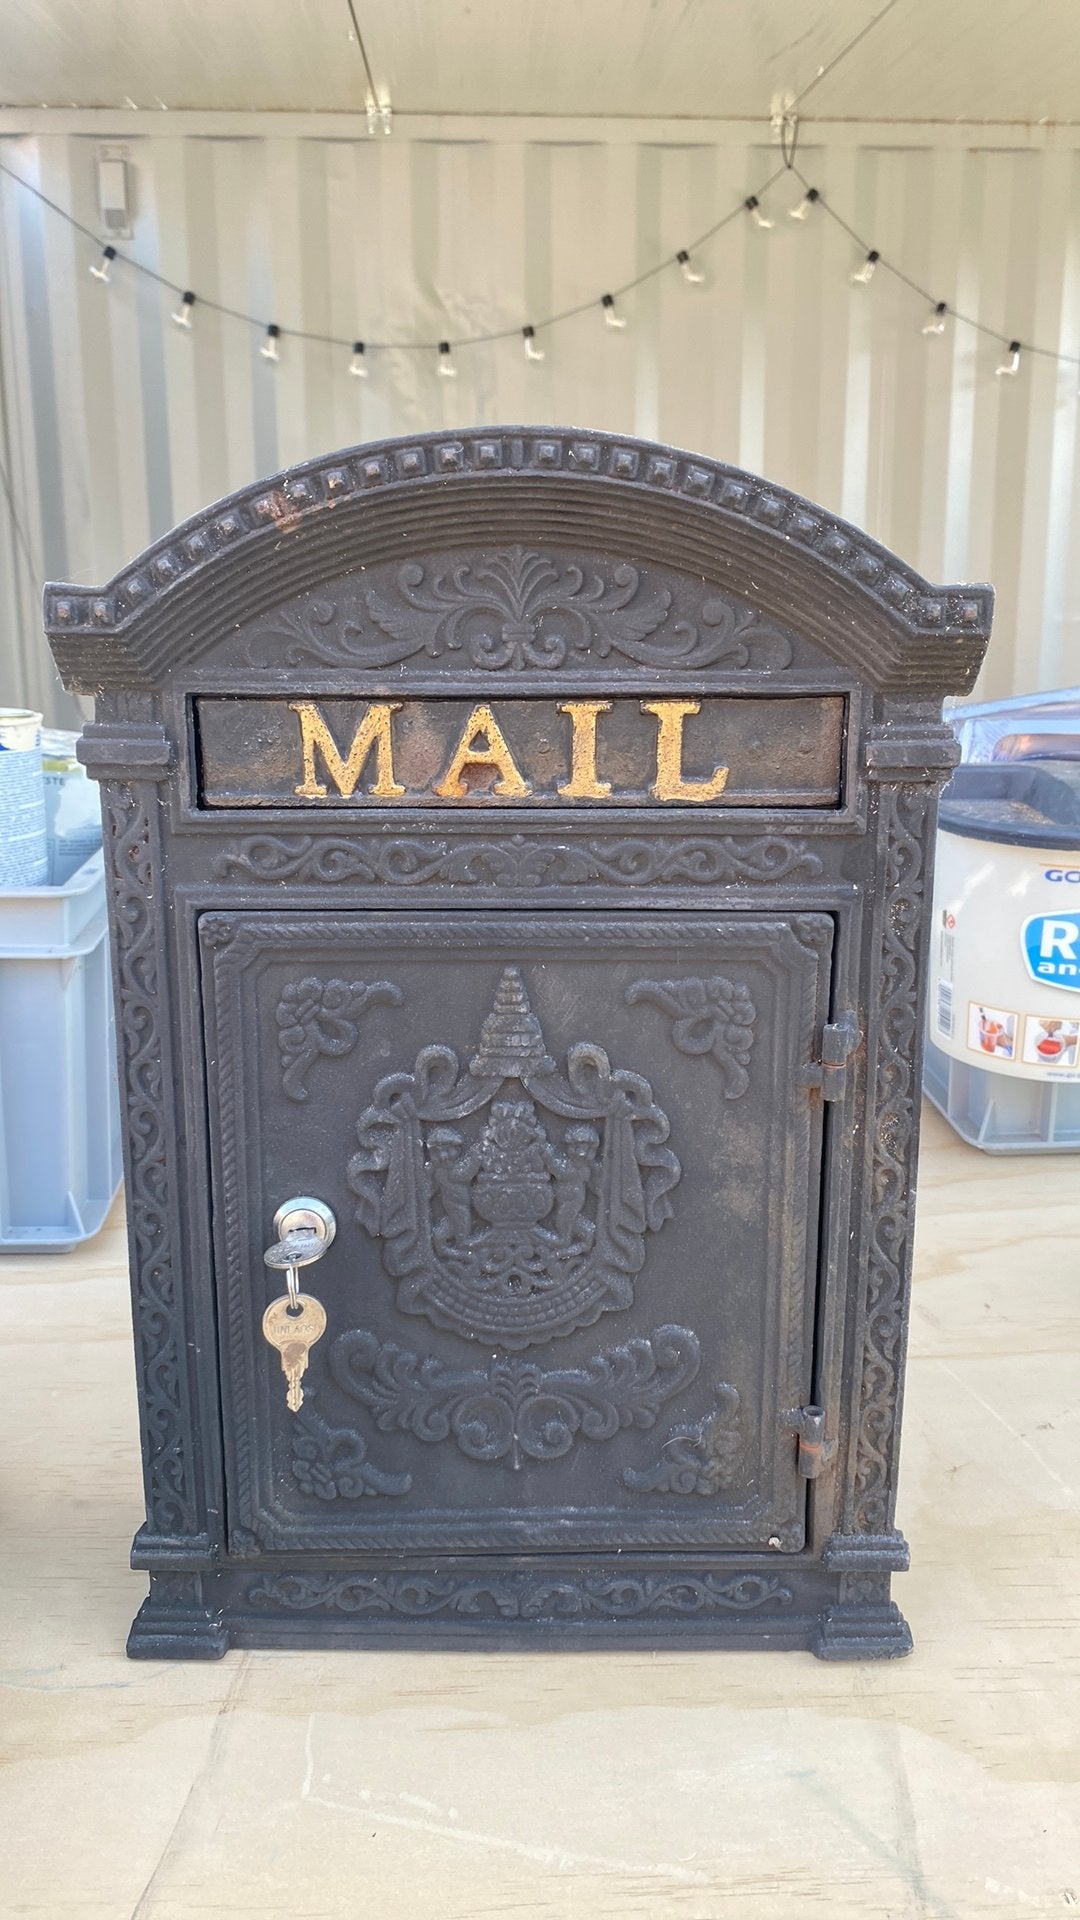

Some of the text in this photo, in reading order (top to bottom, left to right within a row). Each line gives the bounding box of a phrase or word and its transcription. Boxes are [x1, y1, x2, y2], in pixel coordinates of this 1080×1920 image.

[289, 701, 730, 801] MAIL
[1040, 919, 1080, 960] R
[1037, 961, 1080, 976] an
